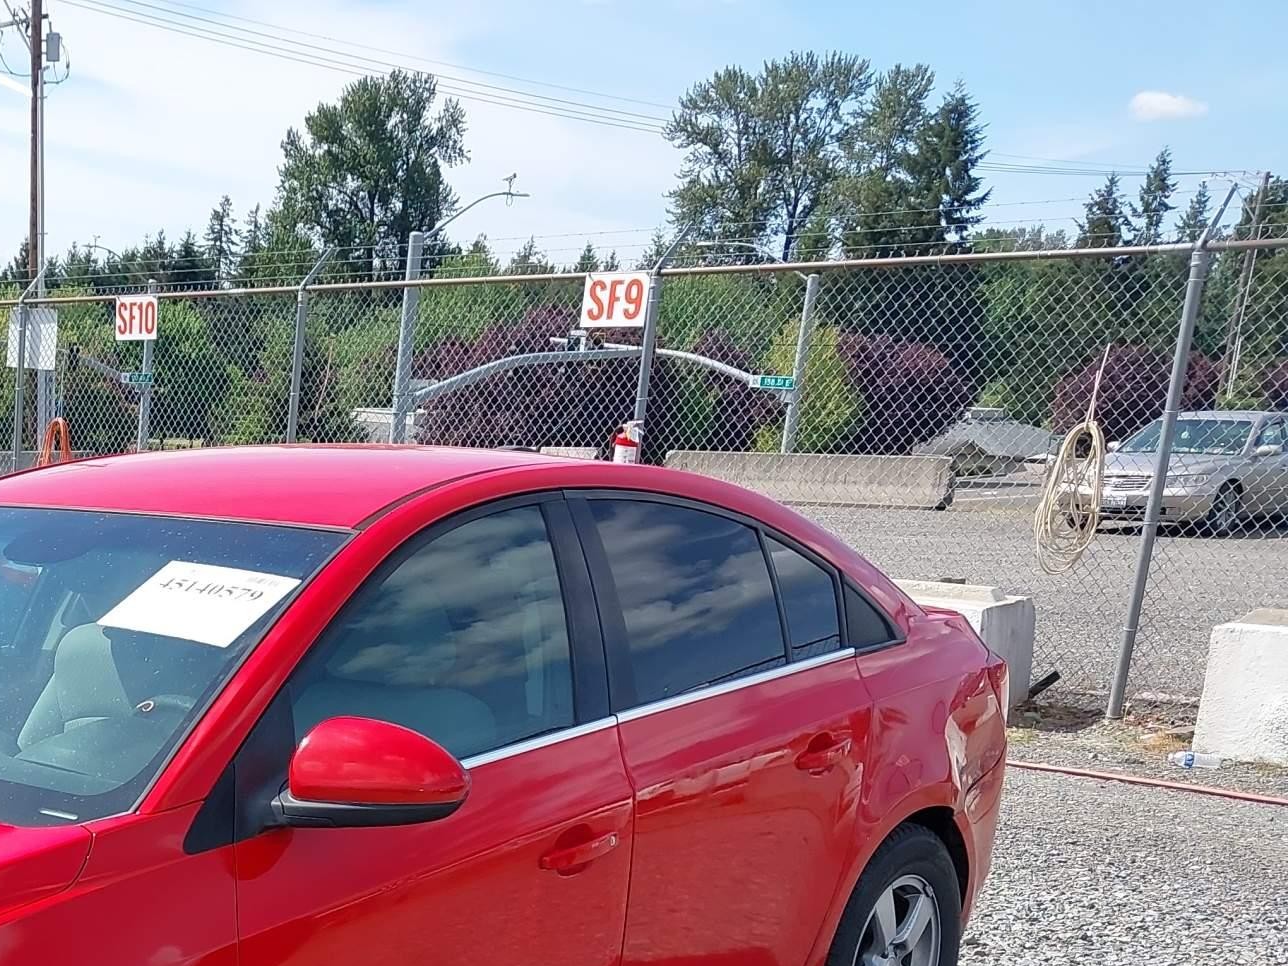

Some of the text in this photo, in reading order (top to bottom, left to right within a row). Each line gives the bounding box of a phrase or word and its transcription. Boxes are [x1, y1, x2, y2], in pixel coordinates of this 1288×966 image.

[587, 278, 643, 321] SF9
[118, 301, 156, 335] SF10
[159, 577, 264, 602] 45140579
